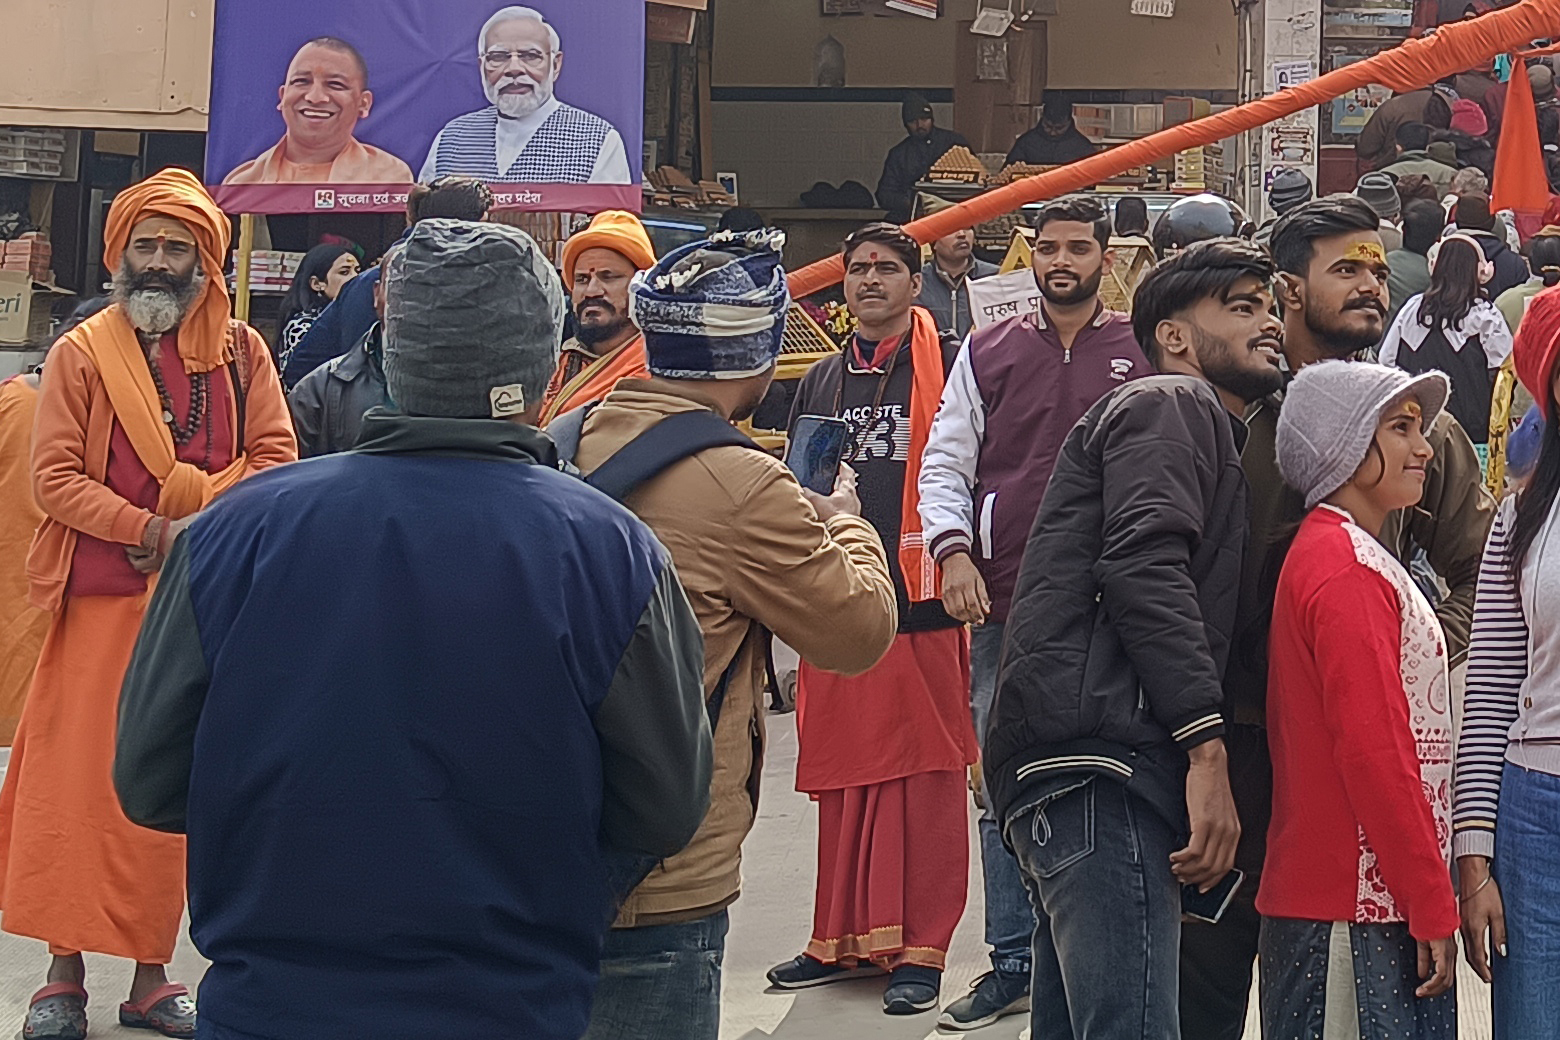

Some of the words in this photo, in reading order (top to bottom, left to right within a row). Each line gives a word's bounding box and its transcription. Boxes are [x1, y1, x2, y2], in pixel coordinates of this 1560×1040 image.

[337, 192, 370, 207] सूचना
[373, 191, 389, 205] एवं
[516, 189, 542, 204] प्रदेश
